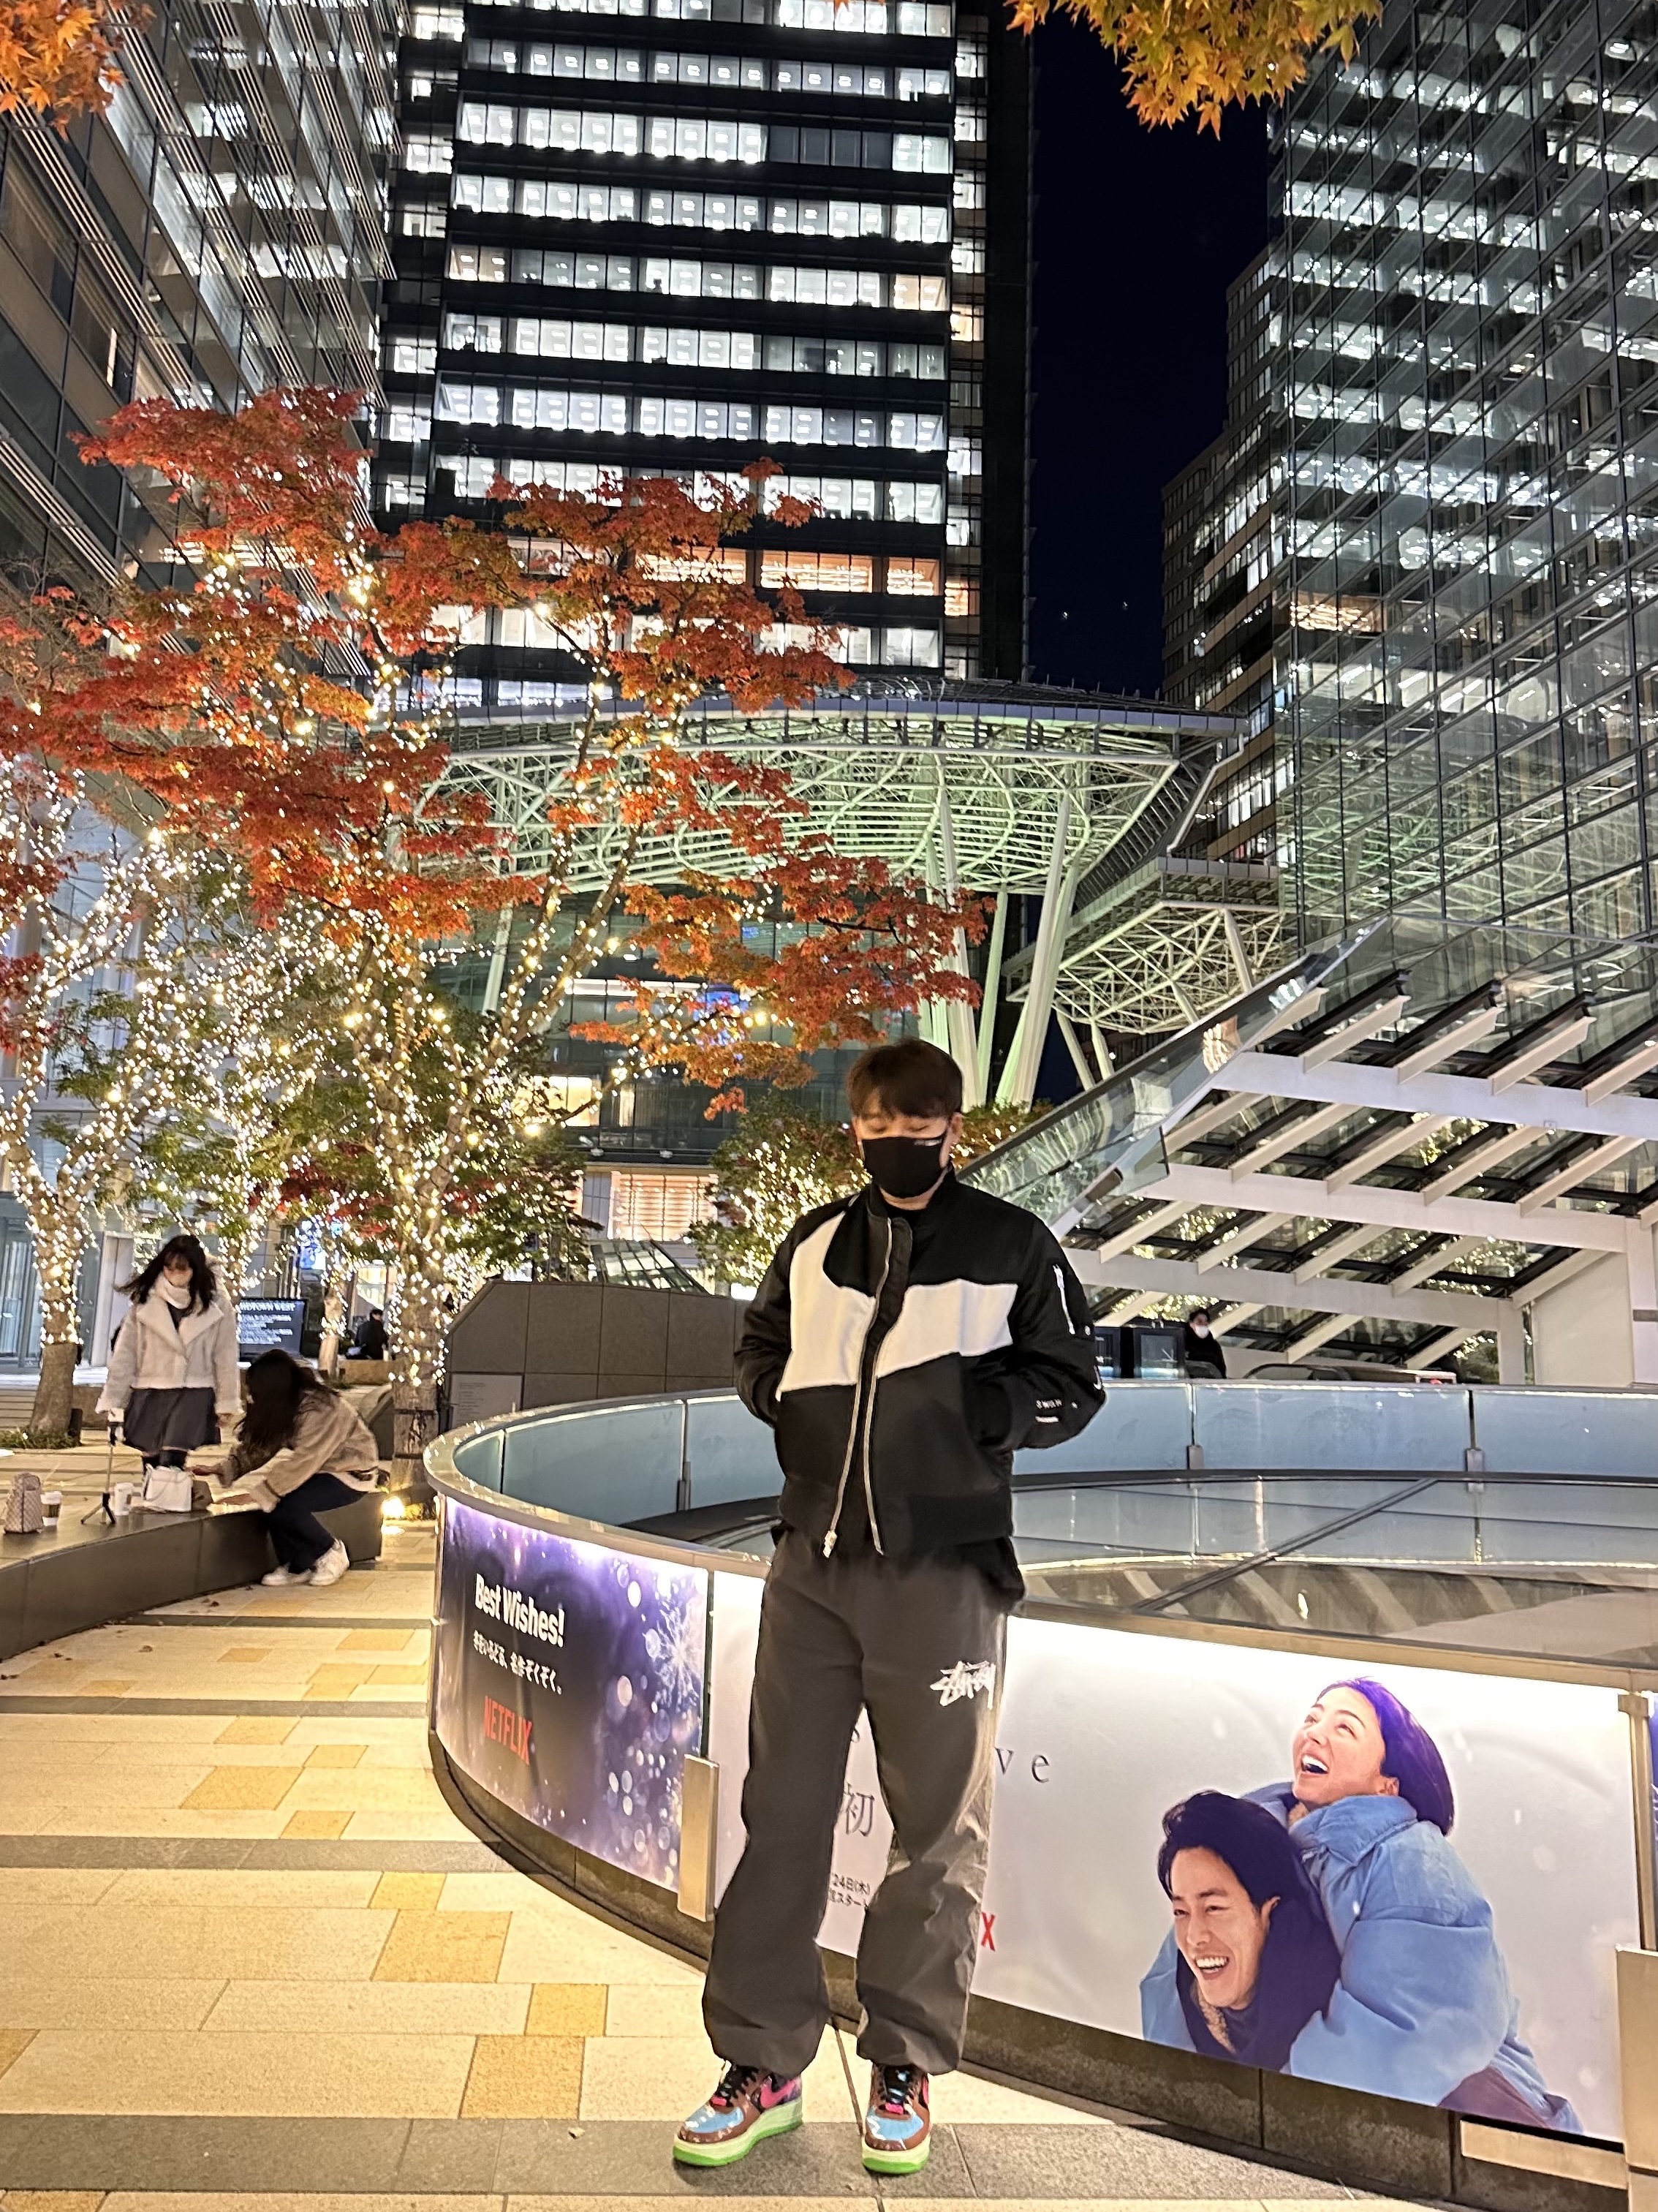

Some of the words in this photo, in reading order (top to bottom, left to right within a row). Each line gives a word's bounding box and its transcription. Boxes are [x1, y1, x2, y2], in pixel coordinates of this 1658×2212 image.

[474, 1572, 501, 1620] Best
[502, 1586, 565, 1648] Wishes!
[484, 1695, 533, 1766] NETFLIX
